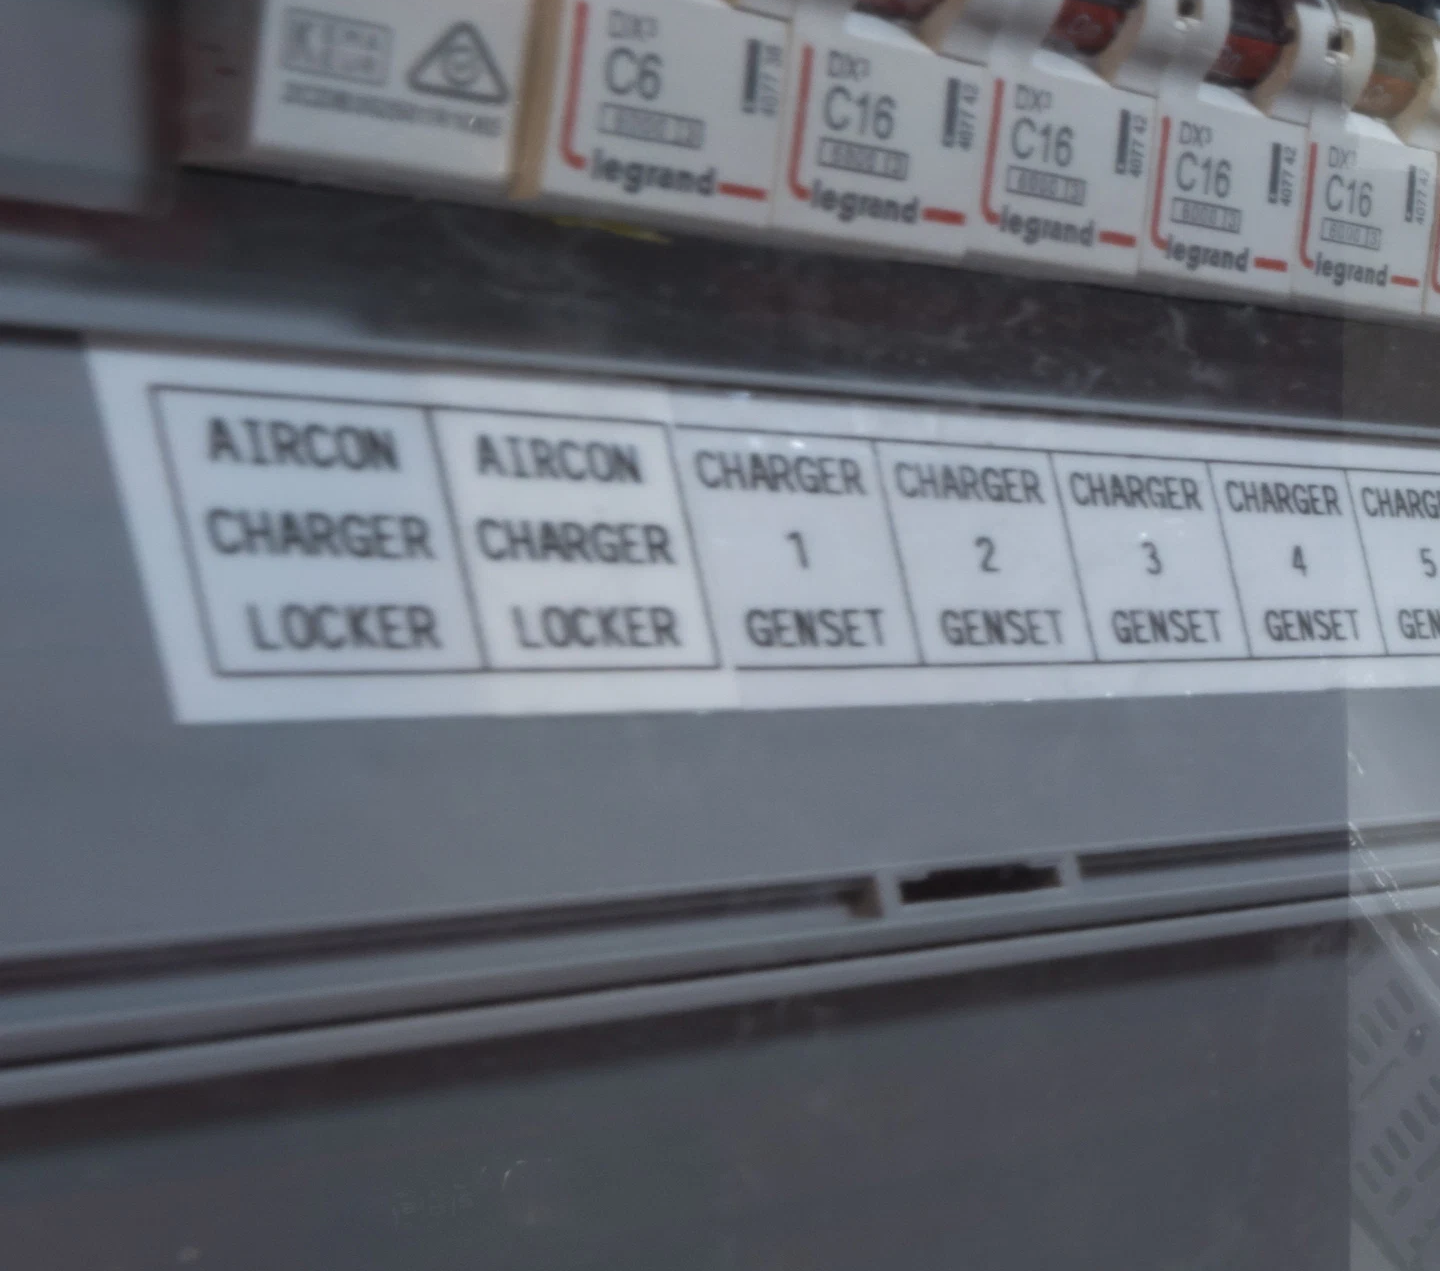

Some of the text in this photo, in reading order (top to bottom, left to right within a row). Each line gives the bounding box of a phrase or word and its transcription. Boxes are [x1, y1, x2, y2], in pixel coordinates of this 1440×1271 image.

[605, 46, 664, 101] C6
[824, 85, 898, 140] C16
[1011, 117, 1074, 168] C16
[592, 147, 717, 197] legrand
[1176, 151, 1232, 198] C16
[812, 178, 920, 224] legrand
[1325, 174, 1373, 218] C16
[999, 204, 1095, 248] legrand
[1166, 233, 1250, 273] legrand
[1315, 251, 1388, 287] legrand
[207, 417, 400, 472] AIRCON
[474, 434, 644, 484] AIRCON
[694, 450, 866, 495] CHARGER
[894, 461, 1046, 505] CHARGER
[1069, 471, 1204, 511] CHARGER
[1225, 480, 1343, 516] CHARGER
[205, 508, 437, 561] CHARGER
[474, 518, 677, 566] CHARGER
[785, 531, 809, 569] 1
[974, 536, 1000, 572] 2
[1140, 541, 1163, 576] 3
[1291, 545, 1308, 576] 4
[1418, 548, 1438, 578] 5
[245, 602, 443, 651] LOCKER
[511, 605, 683, 650] LOCKER
[745, 608, 885, 647] GENSET
[940, 610, 1062, 646] GENSET
[1111, 610, 1221, 645] GENSET
[1263, 609, 1359, 642] GENSET
